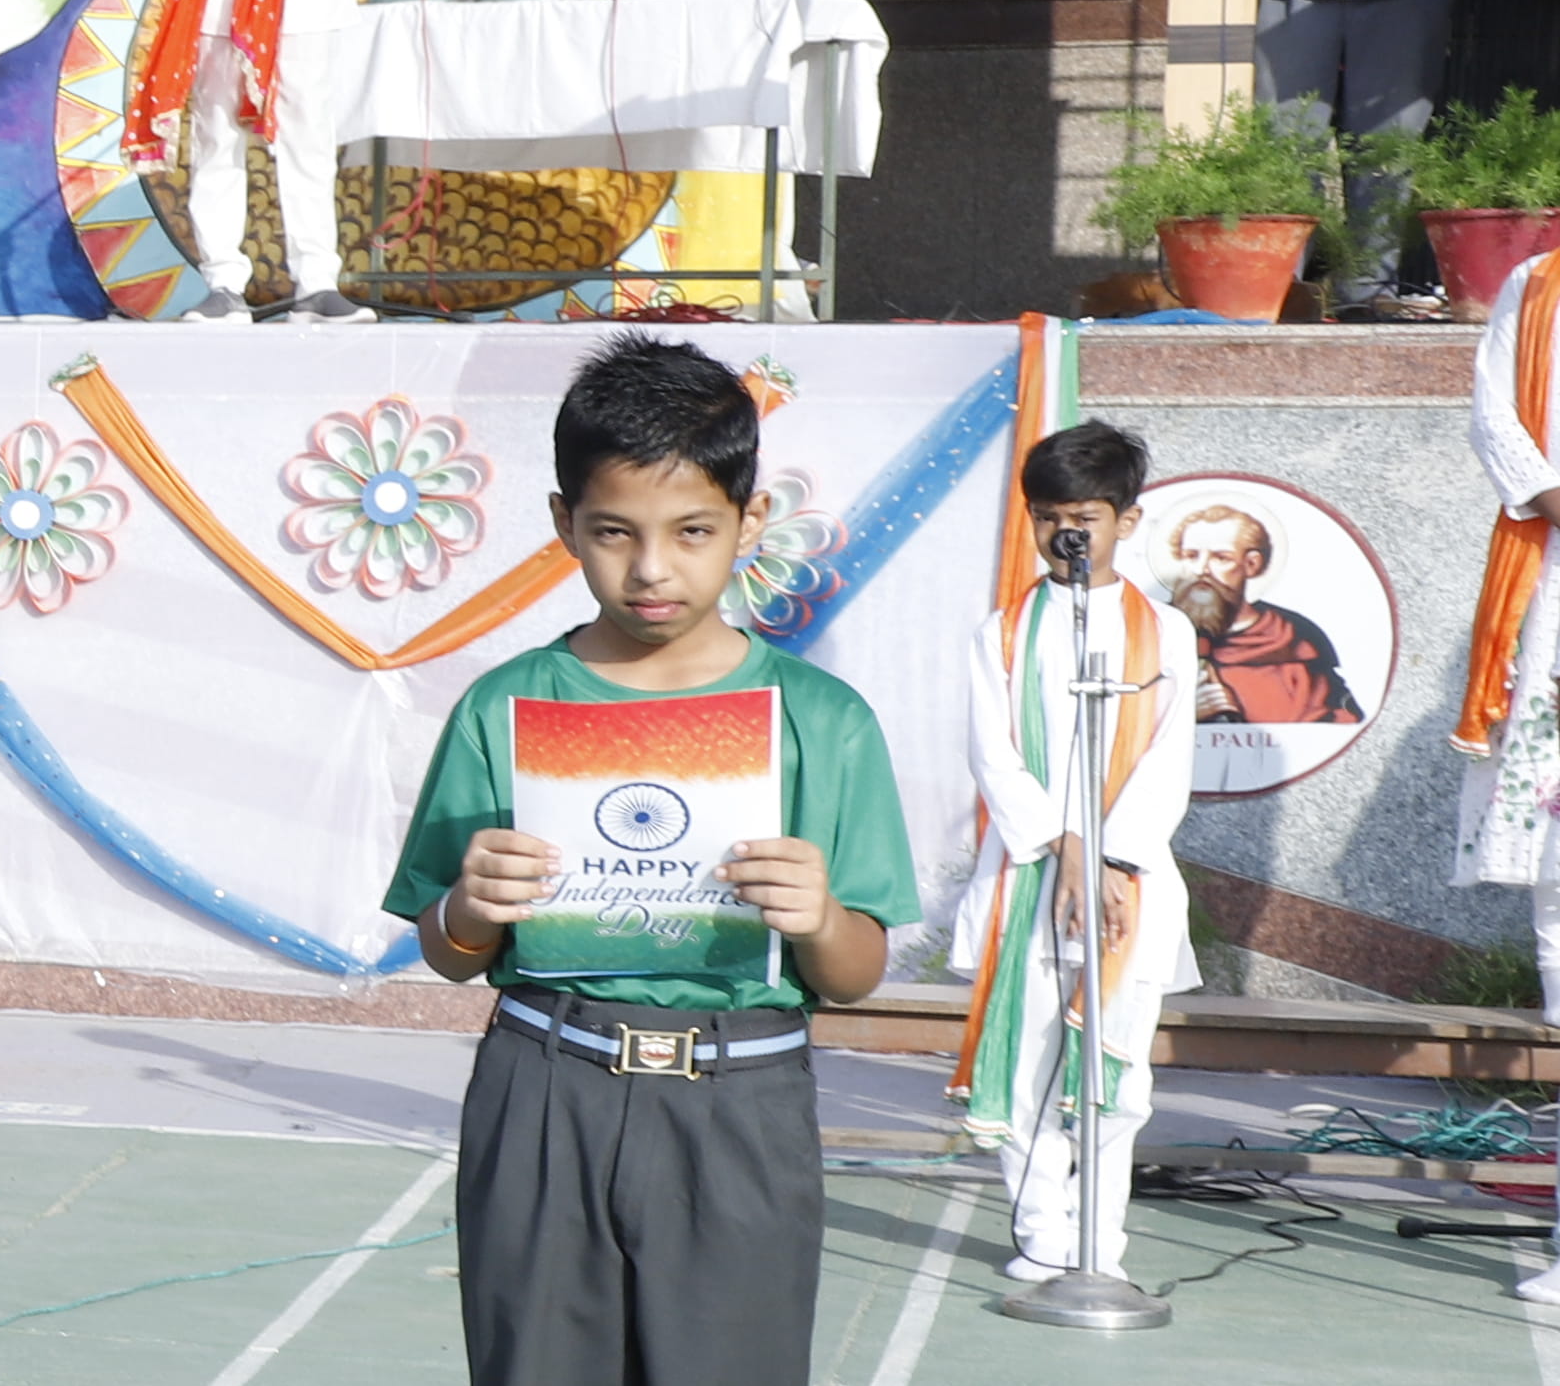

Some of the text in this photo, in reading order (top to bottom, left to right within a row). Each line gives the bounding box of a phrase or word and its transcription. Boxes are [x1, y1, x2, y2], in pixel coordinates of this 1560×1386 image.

[1212, 732, 1280, 748] PAUL
[582, 857, 701, 878] HAPPY
[595, 902, 699, 948] Day
